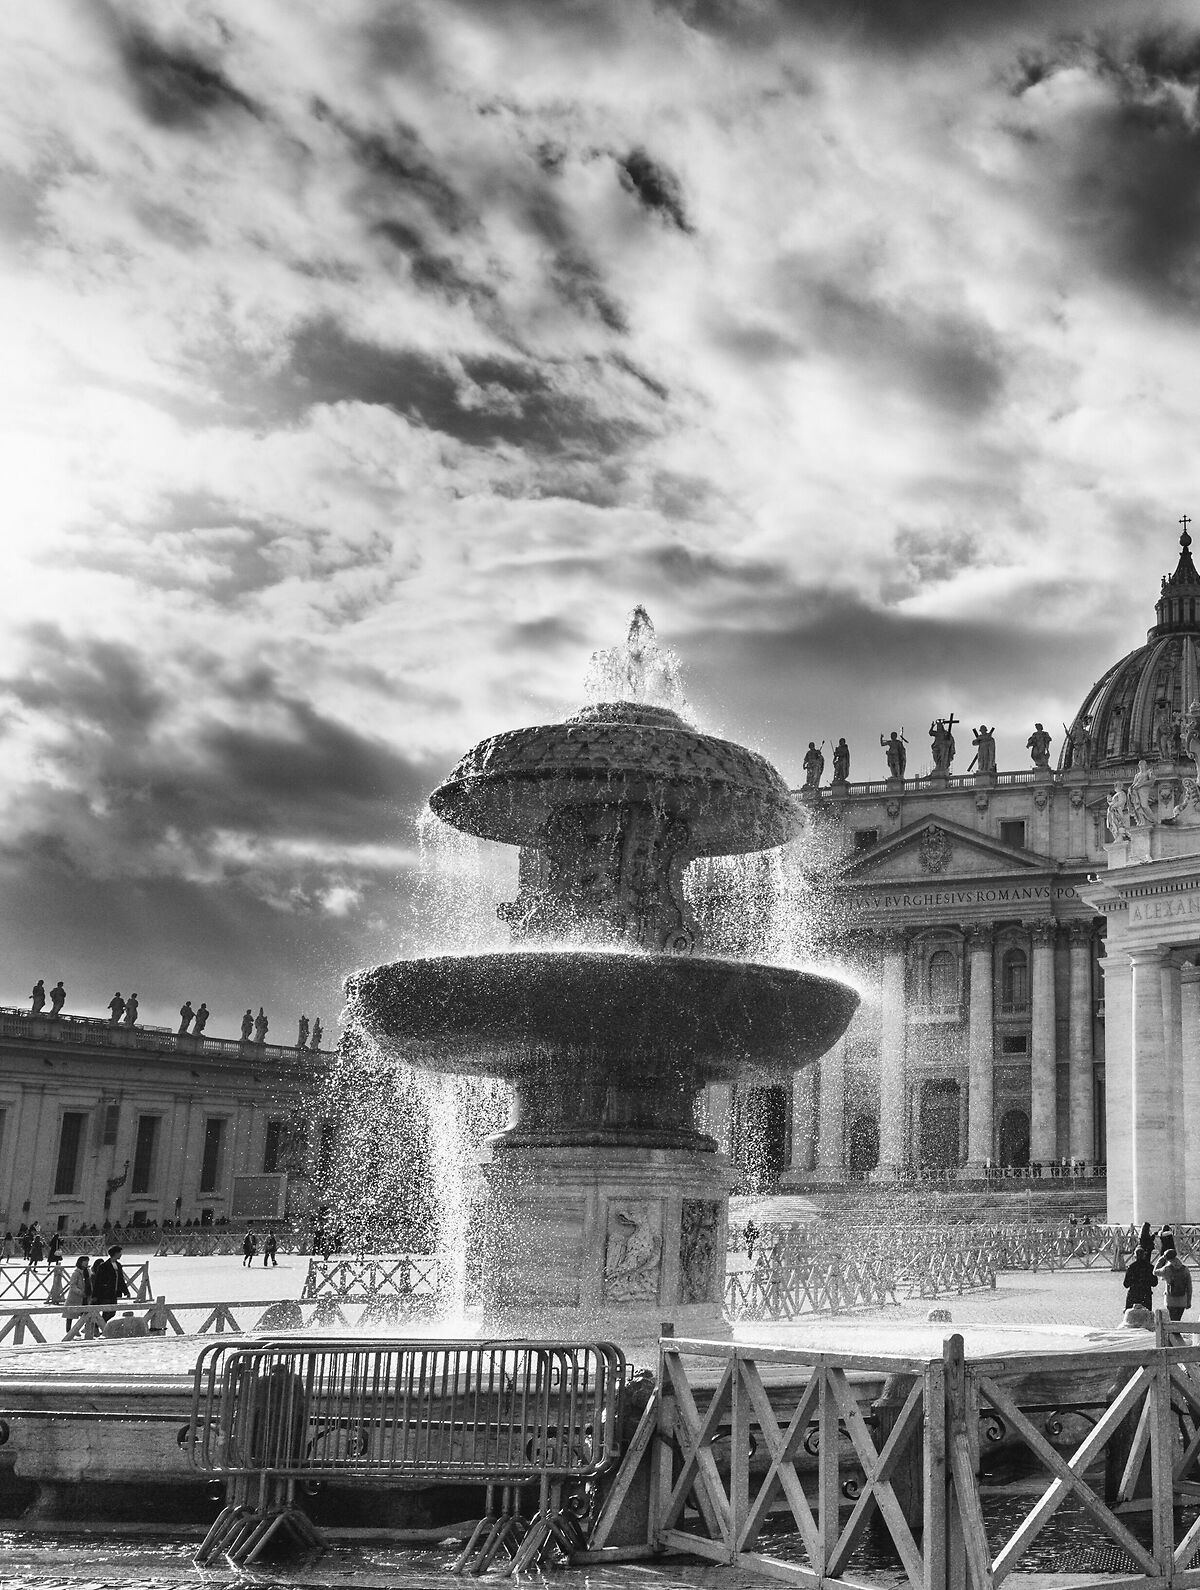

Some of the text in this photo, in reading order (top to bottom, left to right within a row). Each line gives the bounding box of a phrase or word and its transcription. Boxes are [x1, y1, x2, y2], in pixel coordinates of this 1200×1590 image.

[885, 892, 972, 907] BVRGHESIVS
[976, 887, 1050, 902] ROMANVS
[1057, 887, 1079, 899] PO
